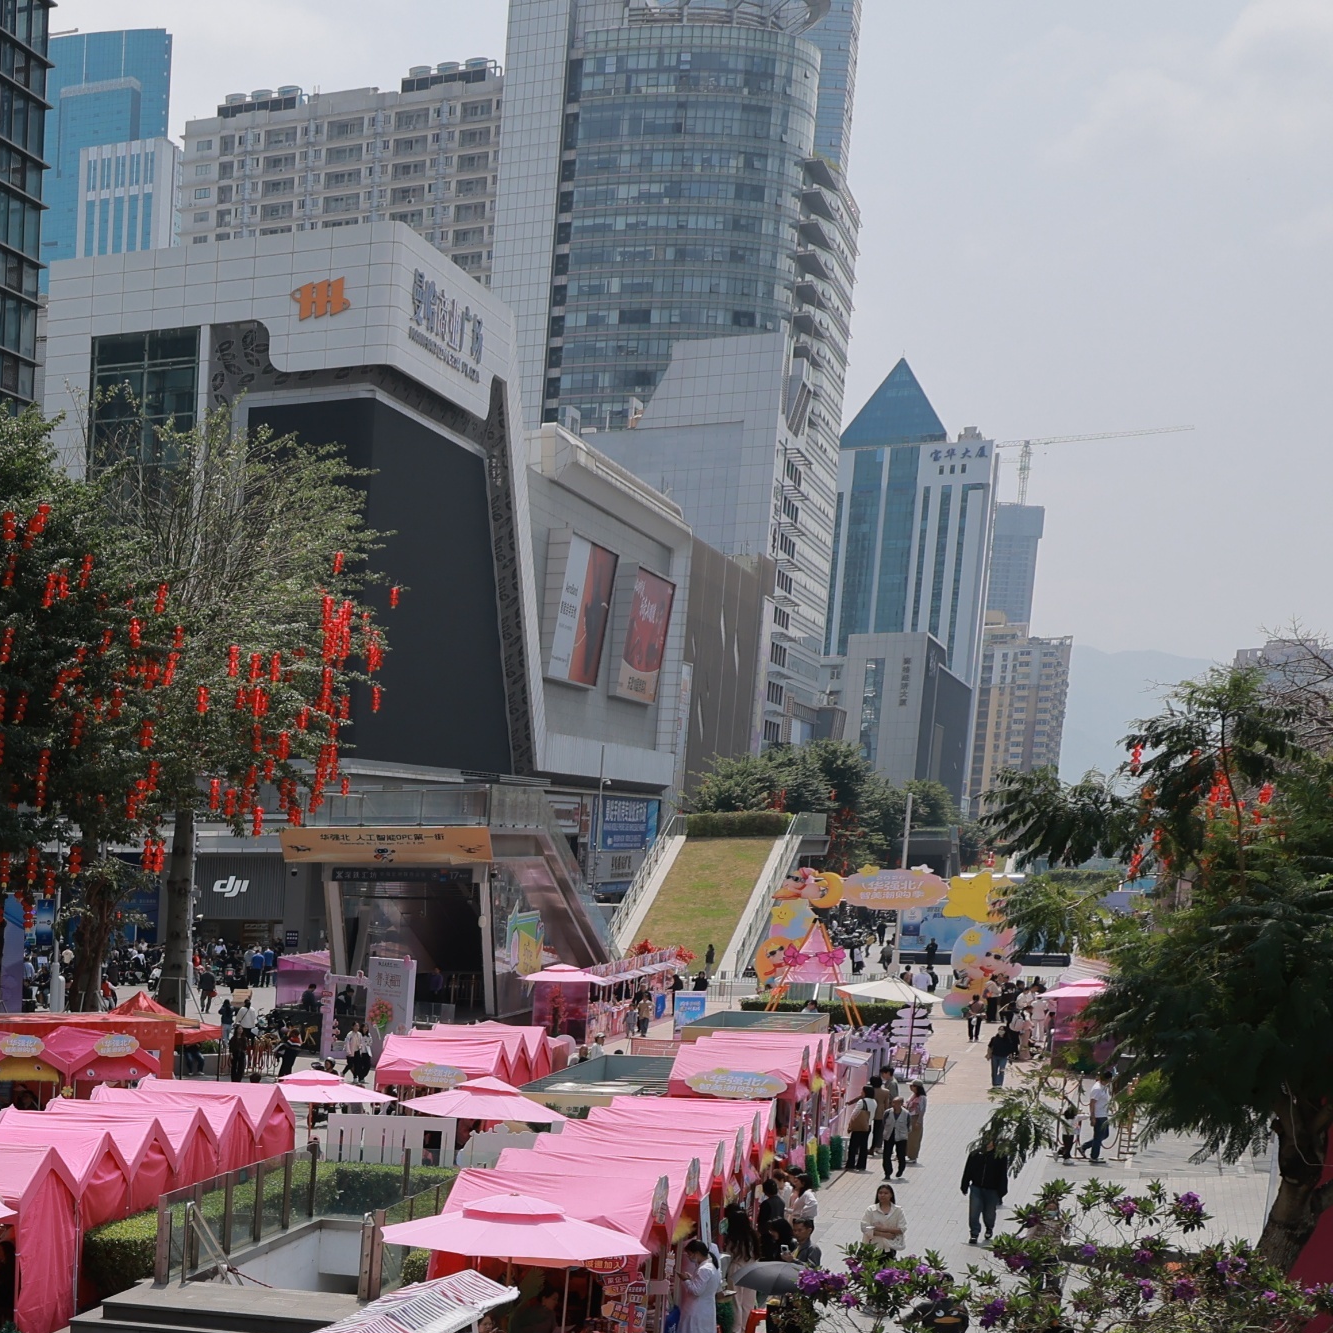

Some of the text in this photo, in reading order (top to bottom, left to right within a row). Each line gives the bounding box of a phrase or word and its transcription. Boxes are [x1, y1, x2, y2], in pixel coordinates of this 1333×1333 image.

[410, 267, 484, 365] 曼哈商业广场
[320, 833, 351, 842] 华强北
